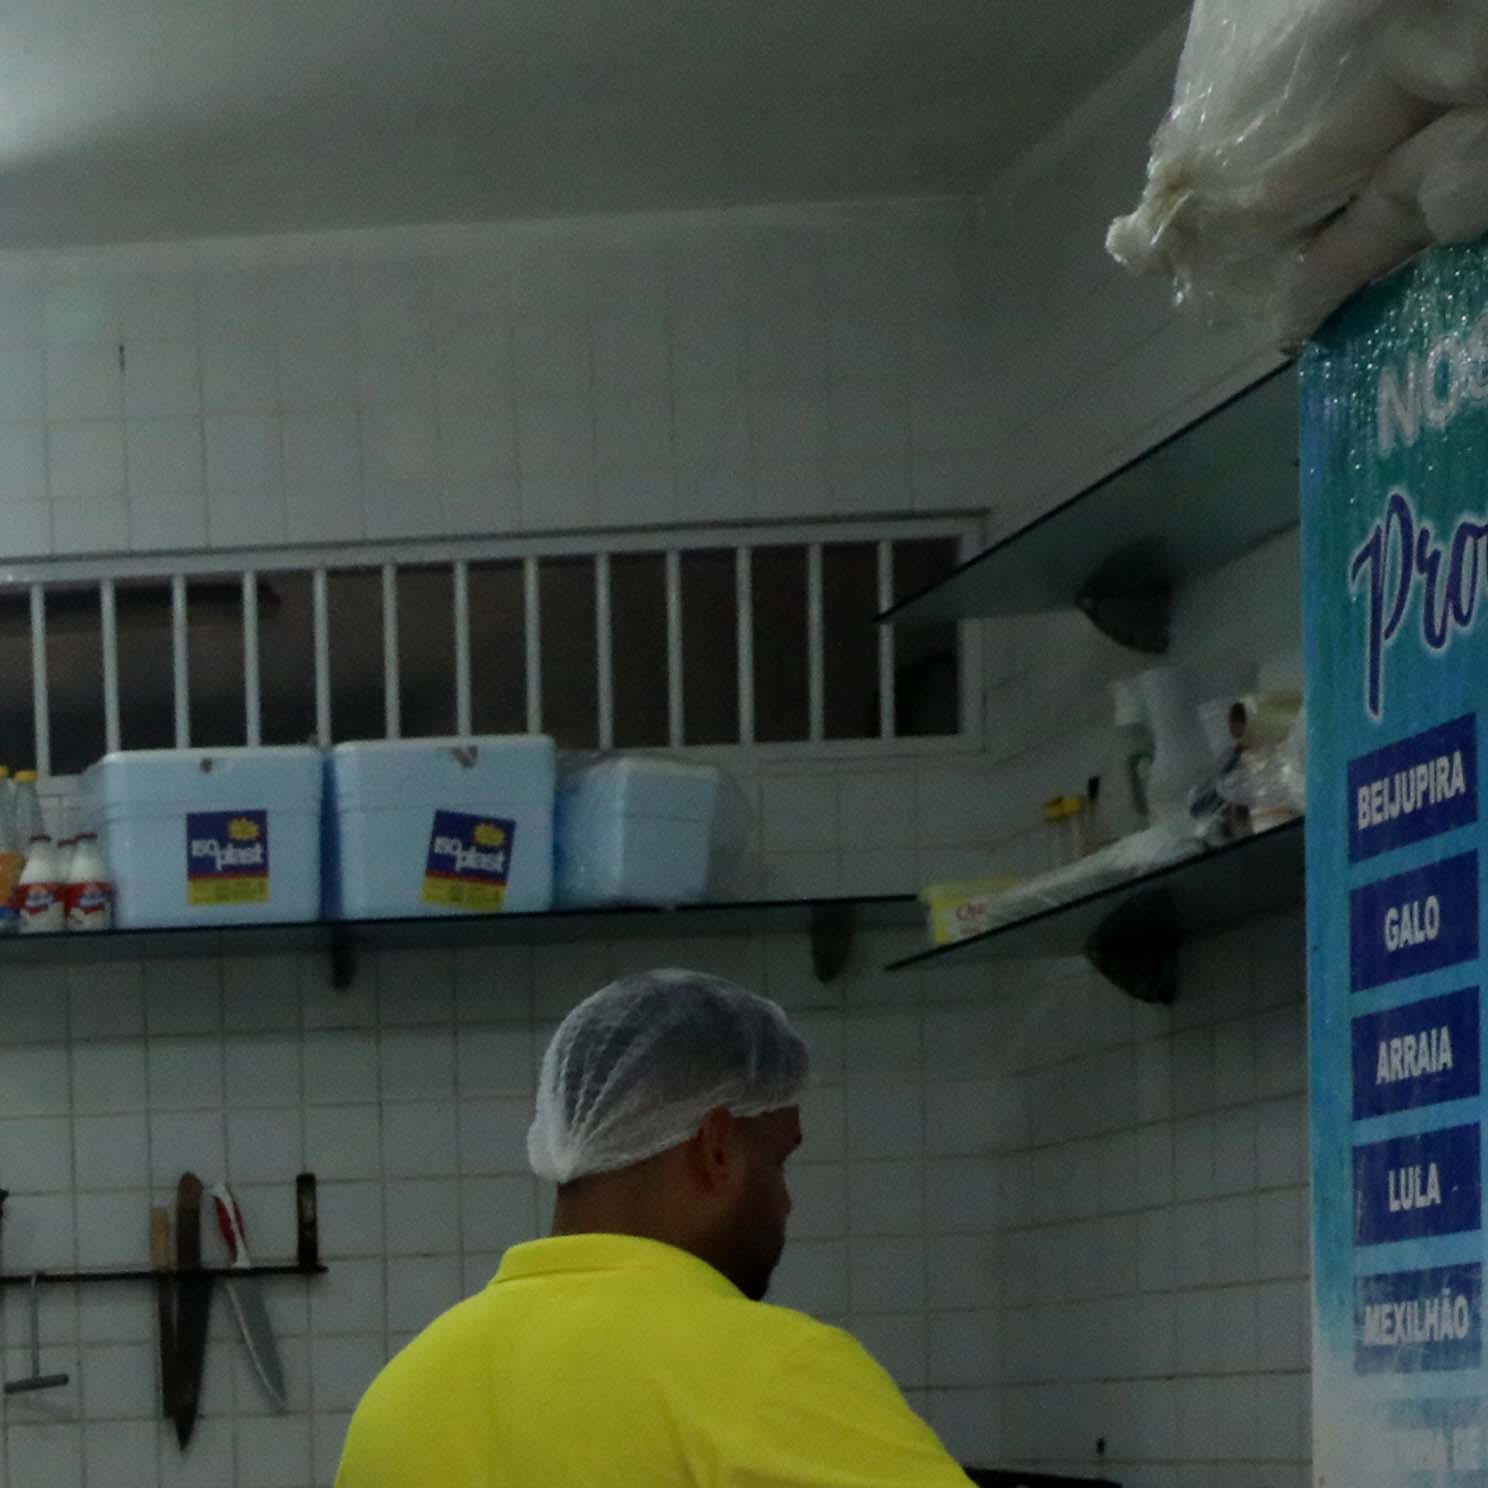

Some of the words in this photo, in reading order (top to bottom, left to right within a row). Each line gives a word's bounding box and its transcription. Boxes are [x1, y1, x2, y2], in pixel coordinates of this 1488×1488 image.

[1357, 751, 1466, 830] BEIJUPIRA
[1384, 896, 1440, 952] GALO
[1376, 1025, 1453, 1084] ARRAIA
[1388, 1163, 1441, 1213] LULA
[1363, 1289, 1470, 1346] MEXILHÃO
